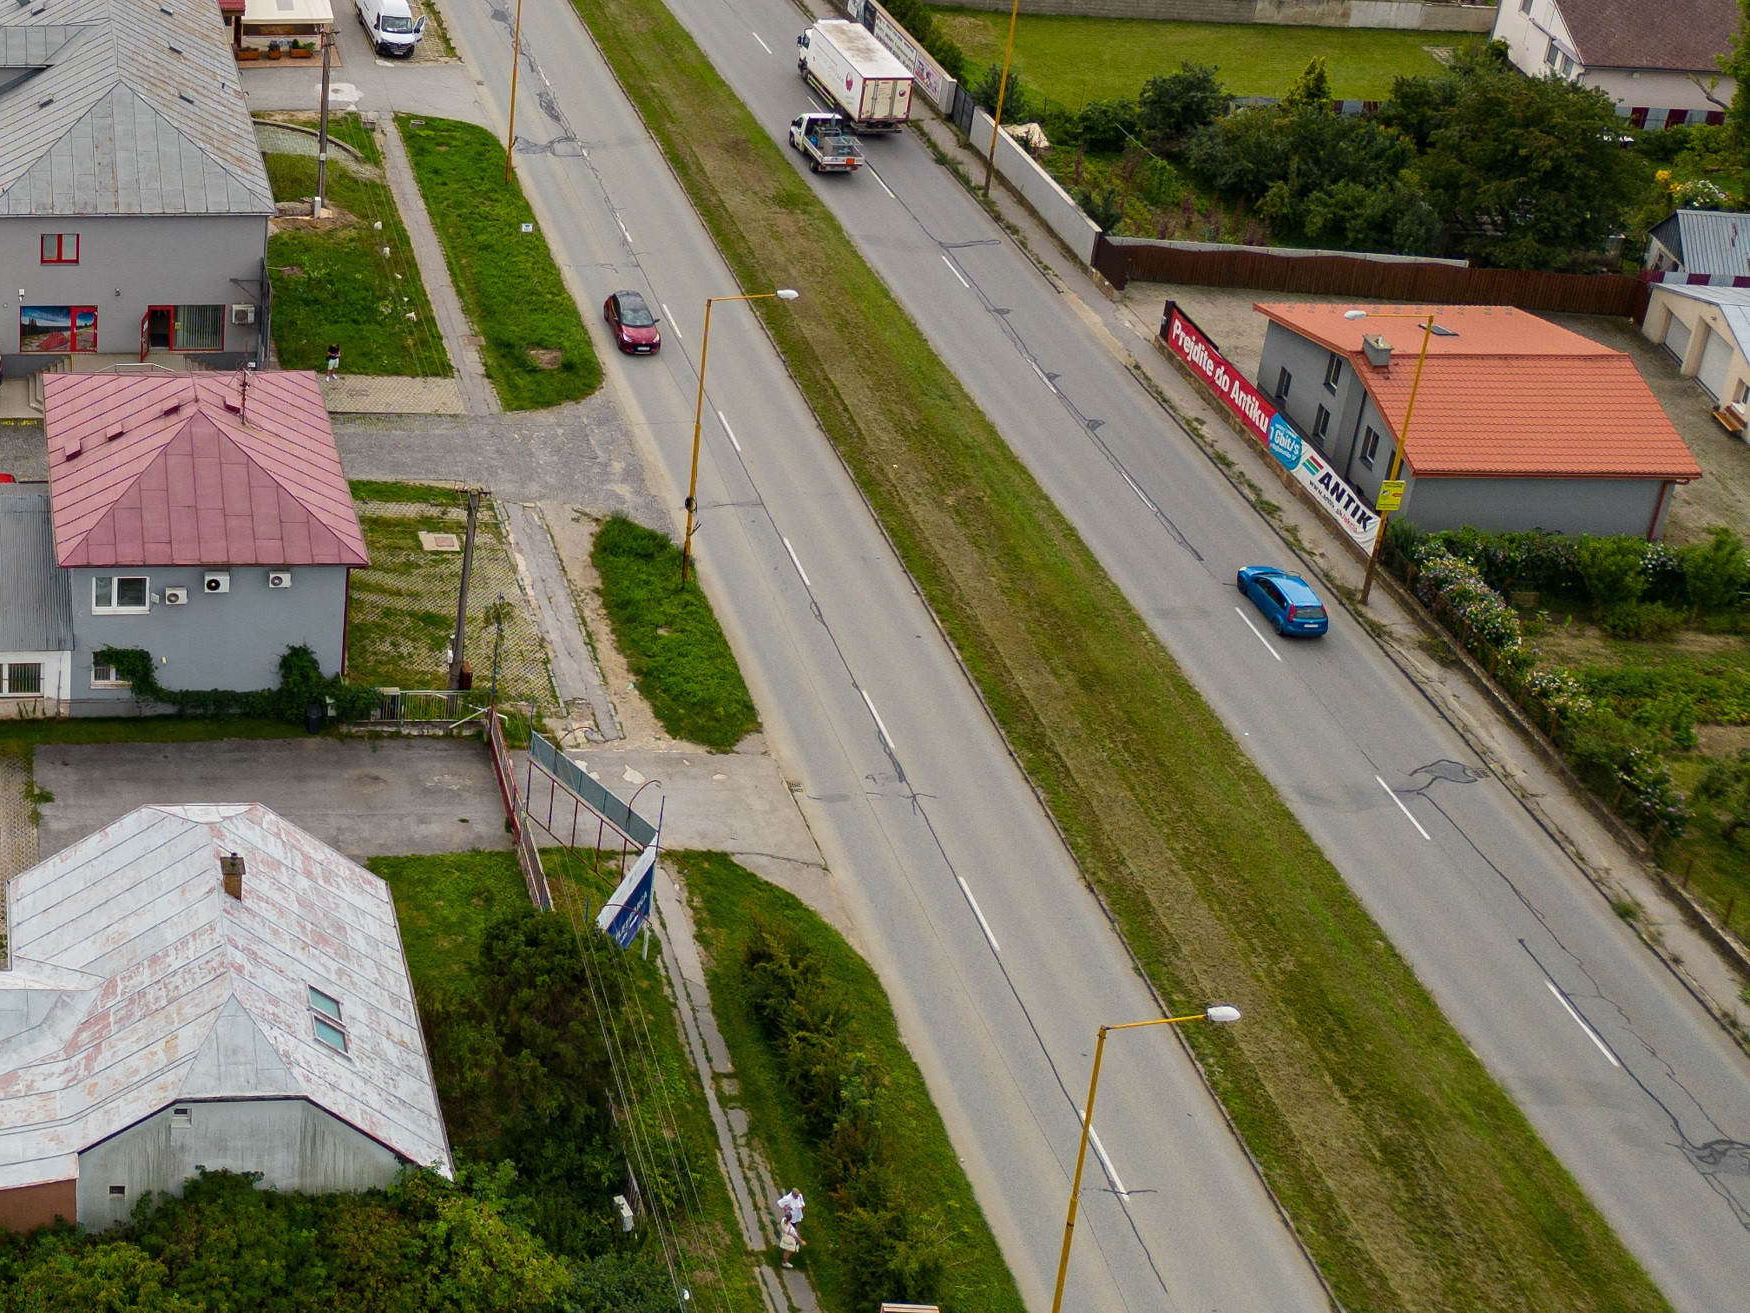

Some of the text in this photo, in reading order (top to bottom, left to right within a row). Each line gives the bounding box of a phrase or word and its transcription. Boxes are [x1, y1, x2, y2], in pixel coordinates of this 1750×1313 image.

[1172, 319, 1269, 434] Prejdite do Antiku
[1275, 430, 1300, 455] Gbit/s
[1318, 471, 1372, 532] ANTIK
